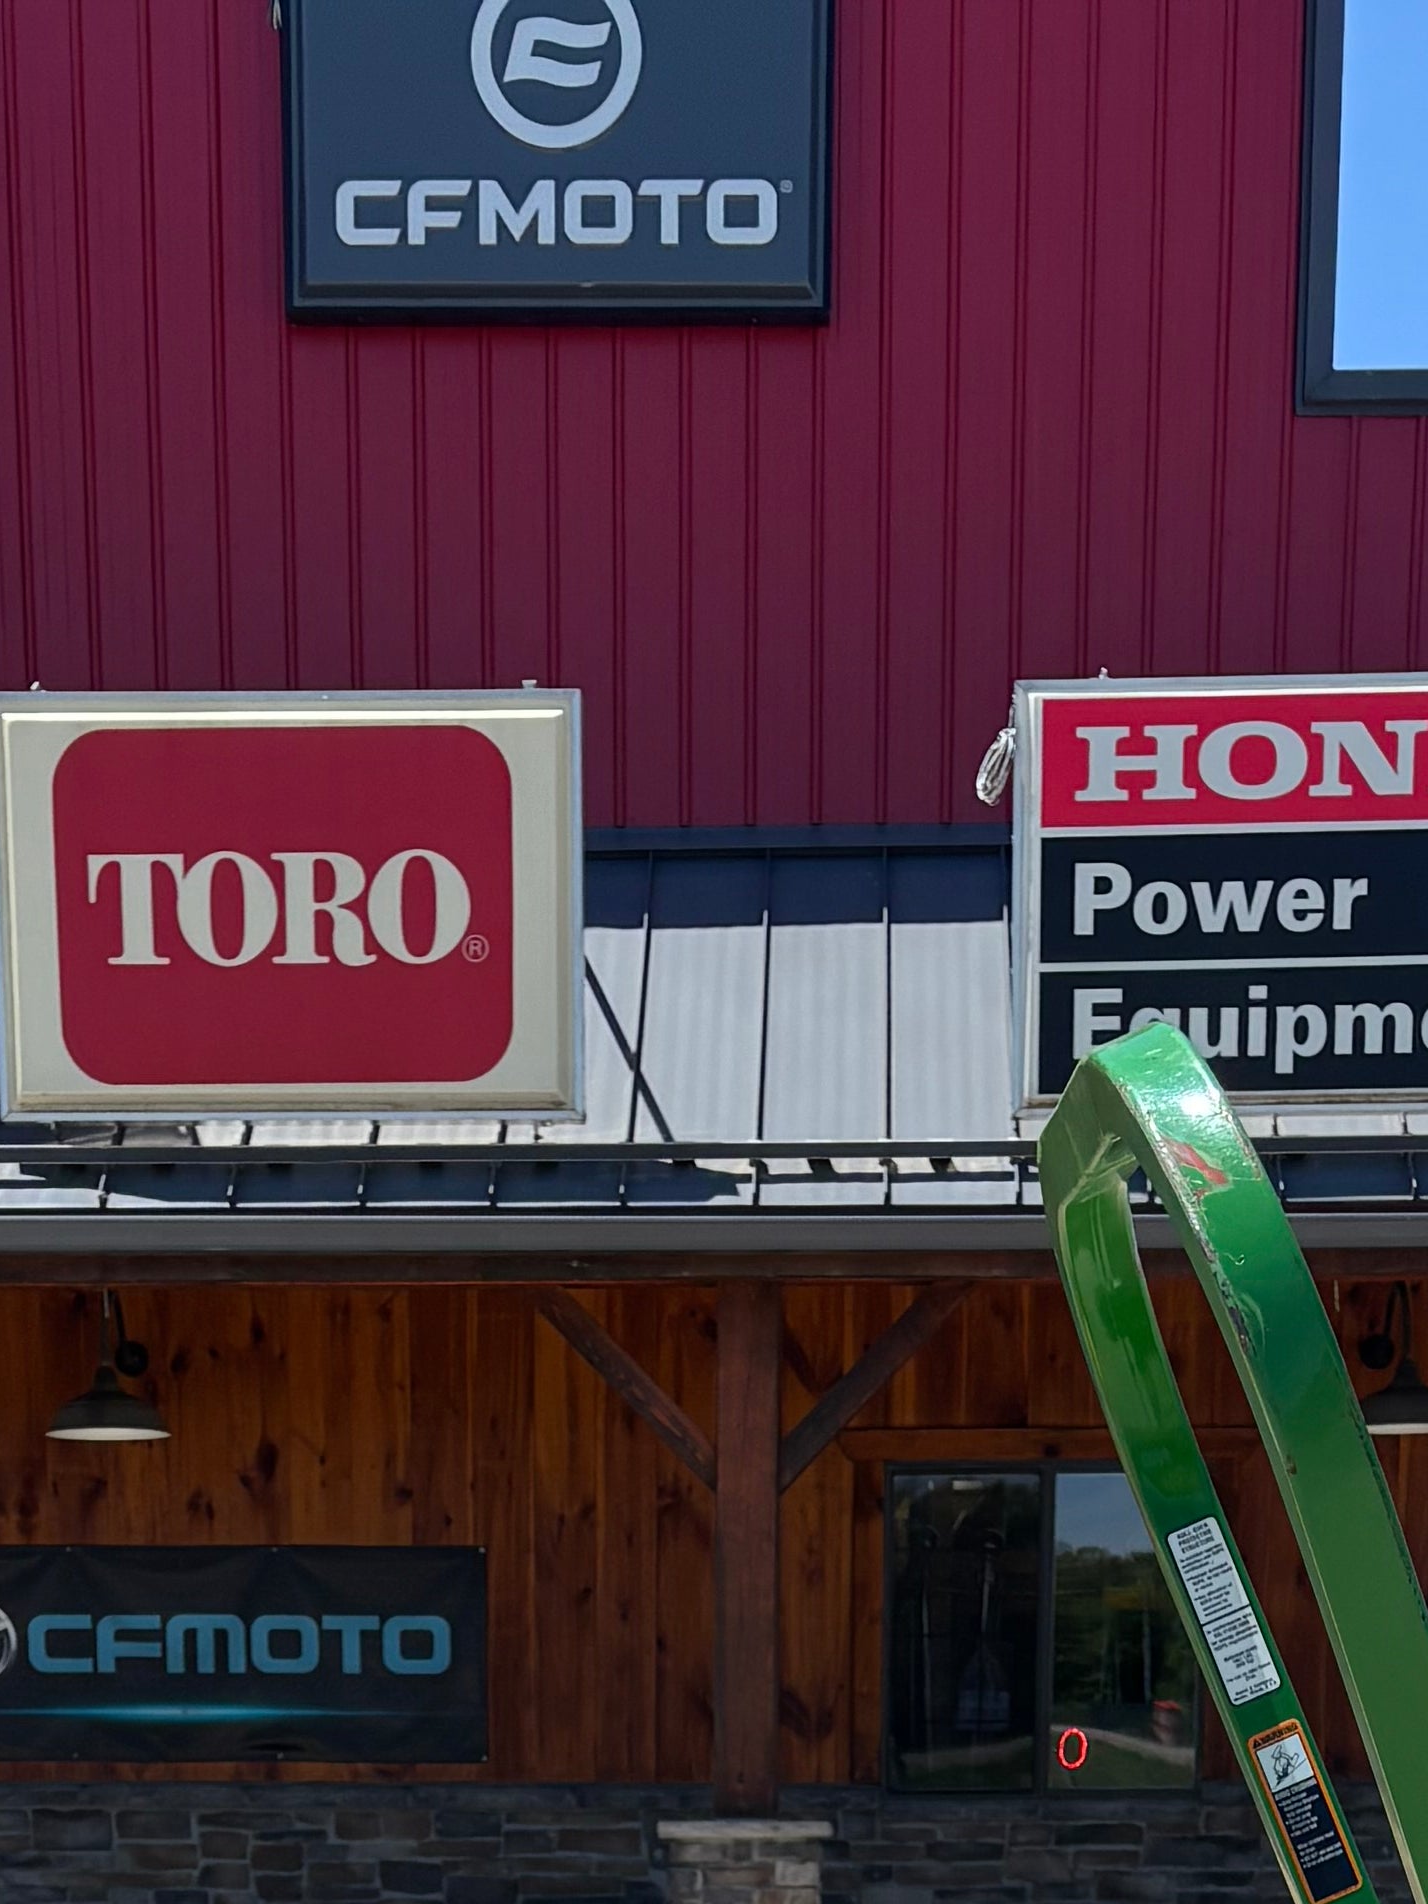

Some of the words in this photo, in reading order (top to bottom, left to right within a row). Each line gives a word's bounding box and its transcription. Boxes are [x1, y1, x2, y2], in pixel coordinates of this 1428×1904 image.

[335, 178, 779, 245] CFMOTO
[86, 848, 471, 968] TORO
[1073, 862, 1368, 936] Power
[27, 1613, 452, 1675] CFMOTO
